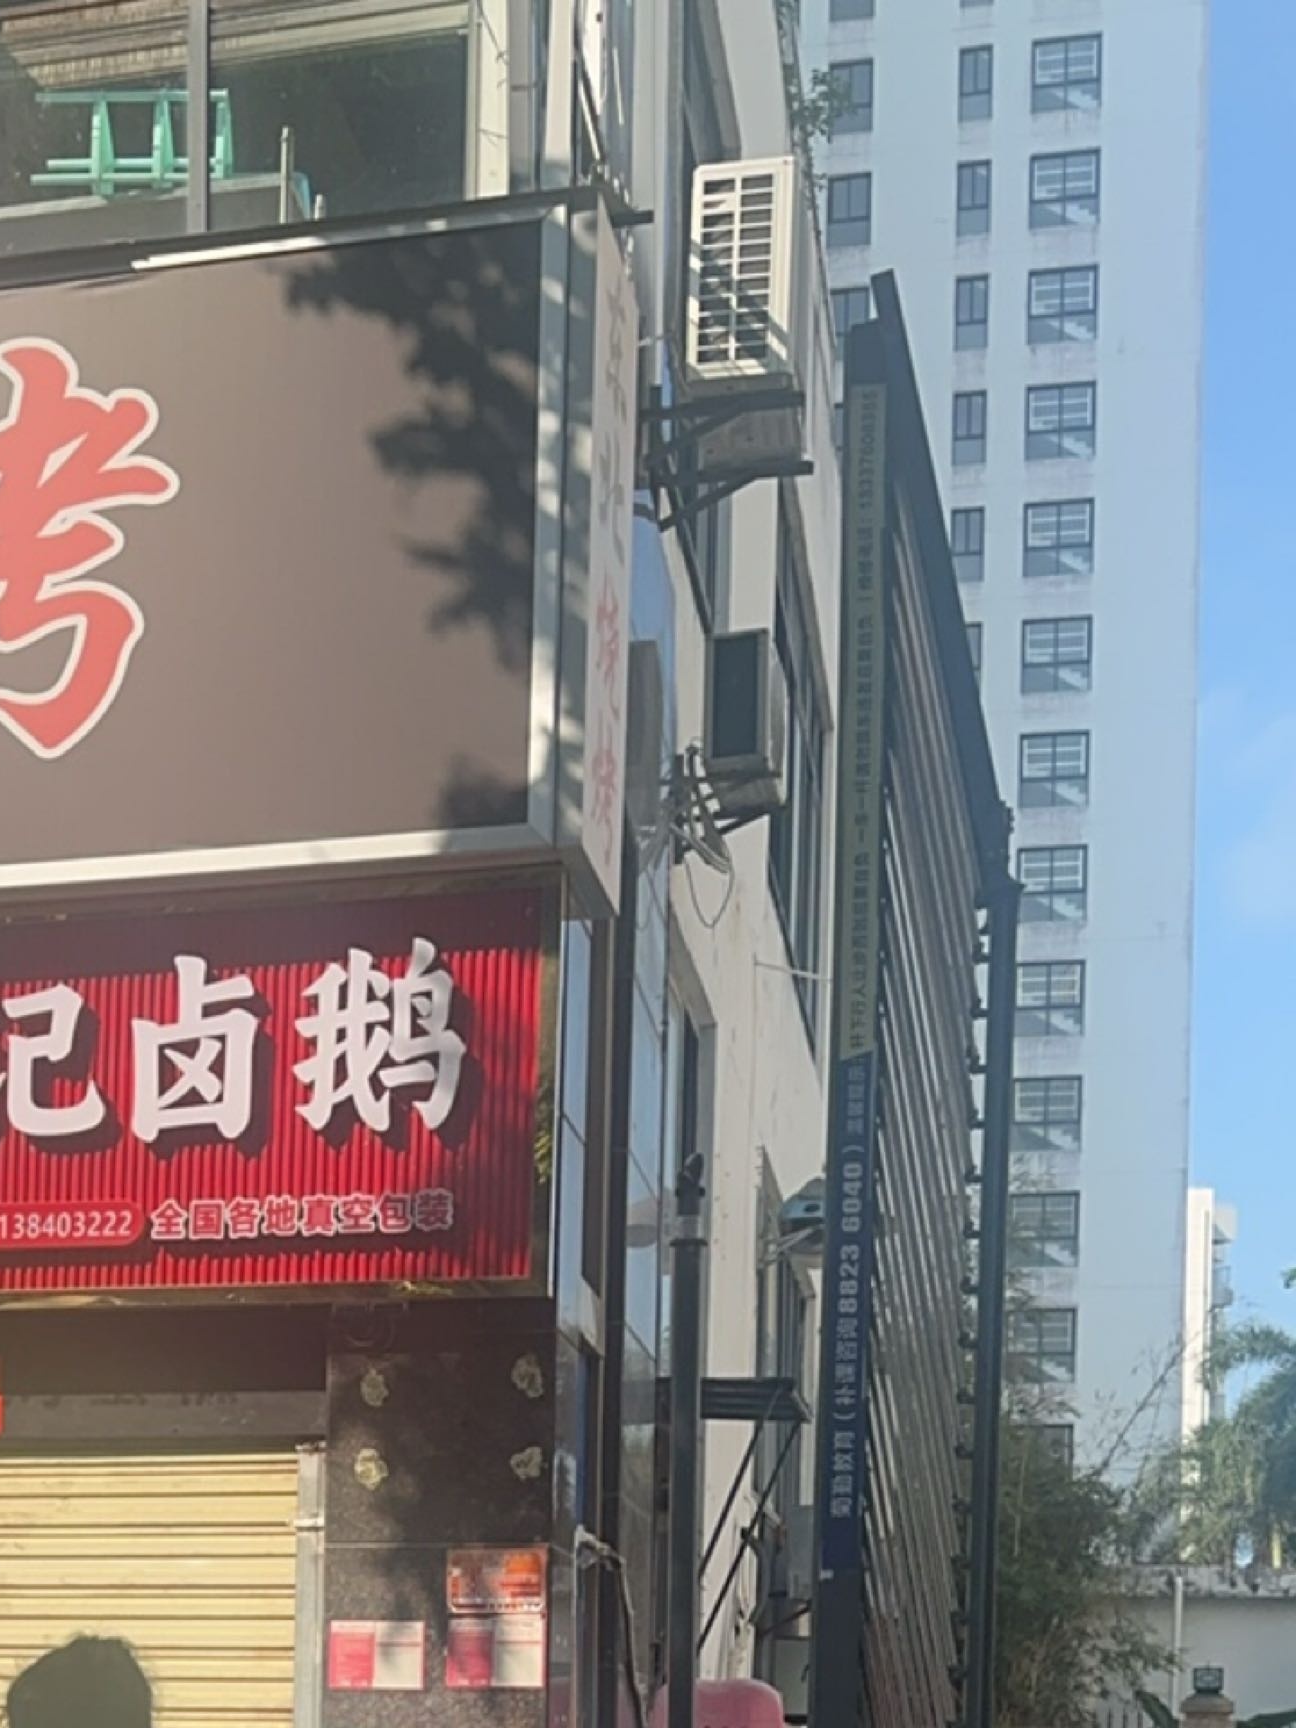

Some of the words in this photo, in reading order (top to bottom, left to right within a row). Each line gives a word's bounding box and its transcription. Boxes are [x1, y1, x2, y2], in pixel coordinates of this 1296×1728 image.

[149, 1187, 455, 1241] 全国各地真空包装
